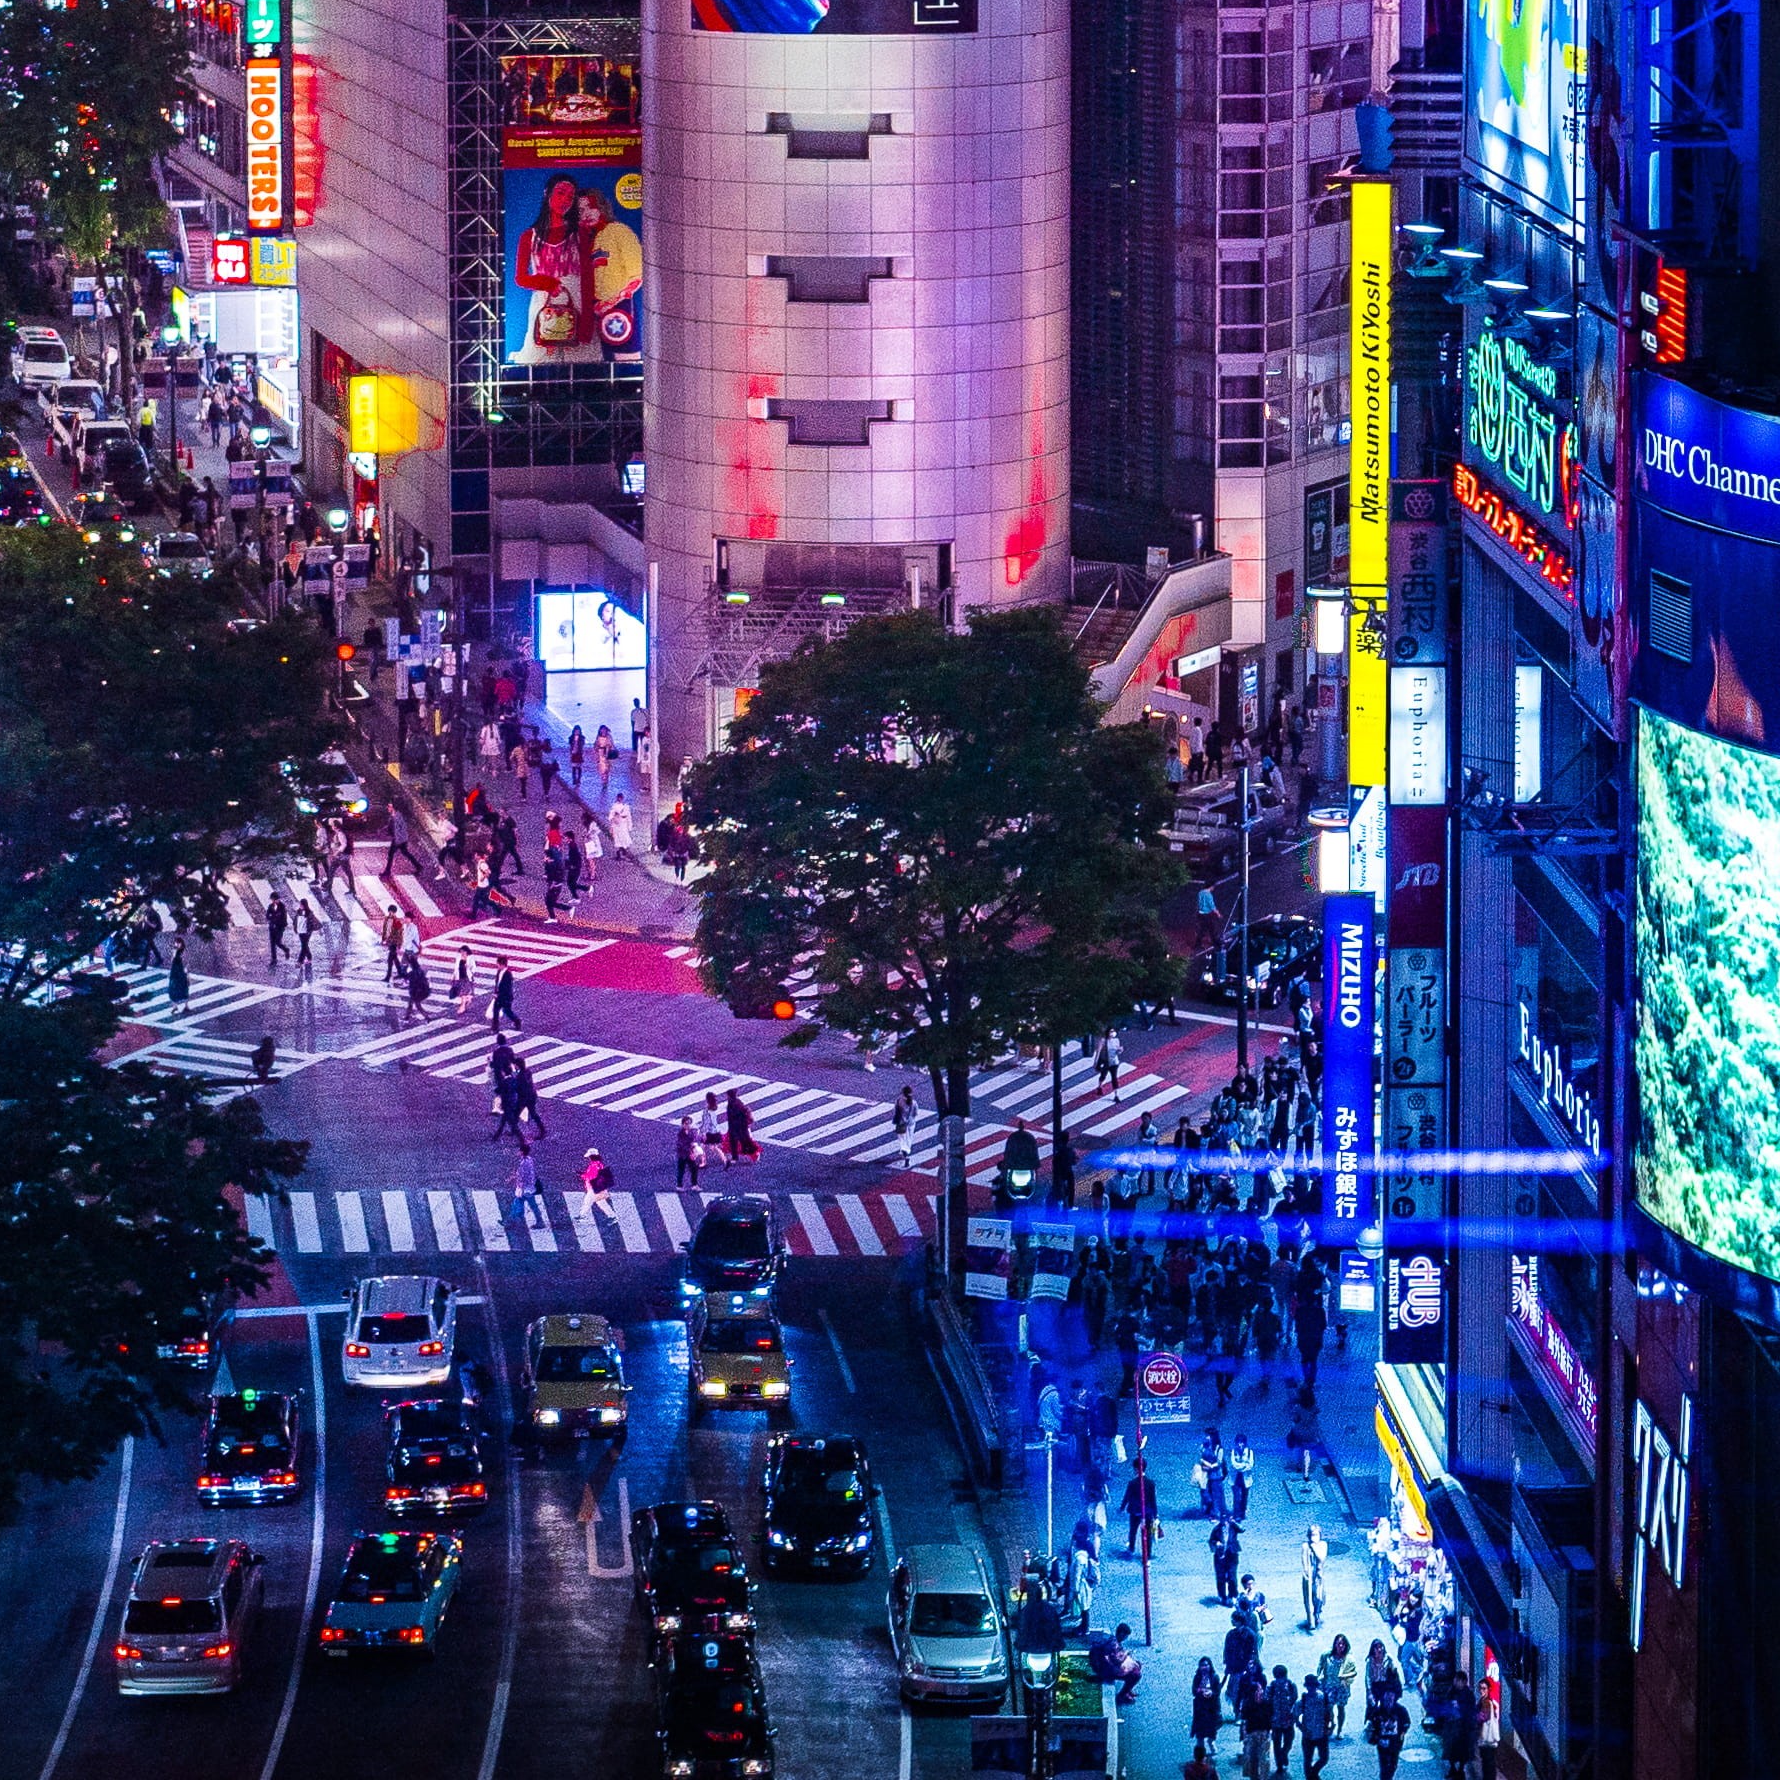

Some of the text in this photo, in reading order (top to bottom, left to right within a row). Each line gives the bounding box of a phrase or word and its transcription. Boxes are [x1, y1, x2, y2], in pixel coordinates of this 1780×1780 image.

[250, 75, 279, 215] HOOTERS
[1360, 367, 1383, 525] Matsumoto
[1644, 427, 1686, 480] DHC
[1408, 676, 1427, 780] Euphoria
[1339, 922, 1363, 1029] MIZUHO
[1396, 986, 1415, 1053] パーラー
[1419, 974, 1438, 1044] フルーツ
[1518, 1001, 1600, 1158] Euphoria
[1335, 1106, 1358, 1220] みずほ銀行
[1399, 1255, 1441, 1328] HUB
